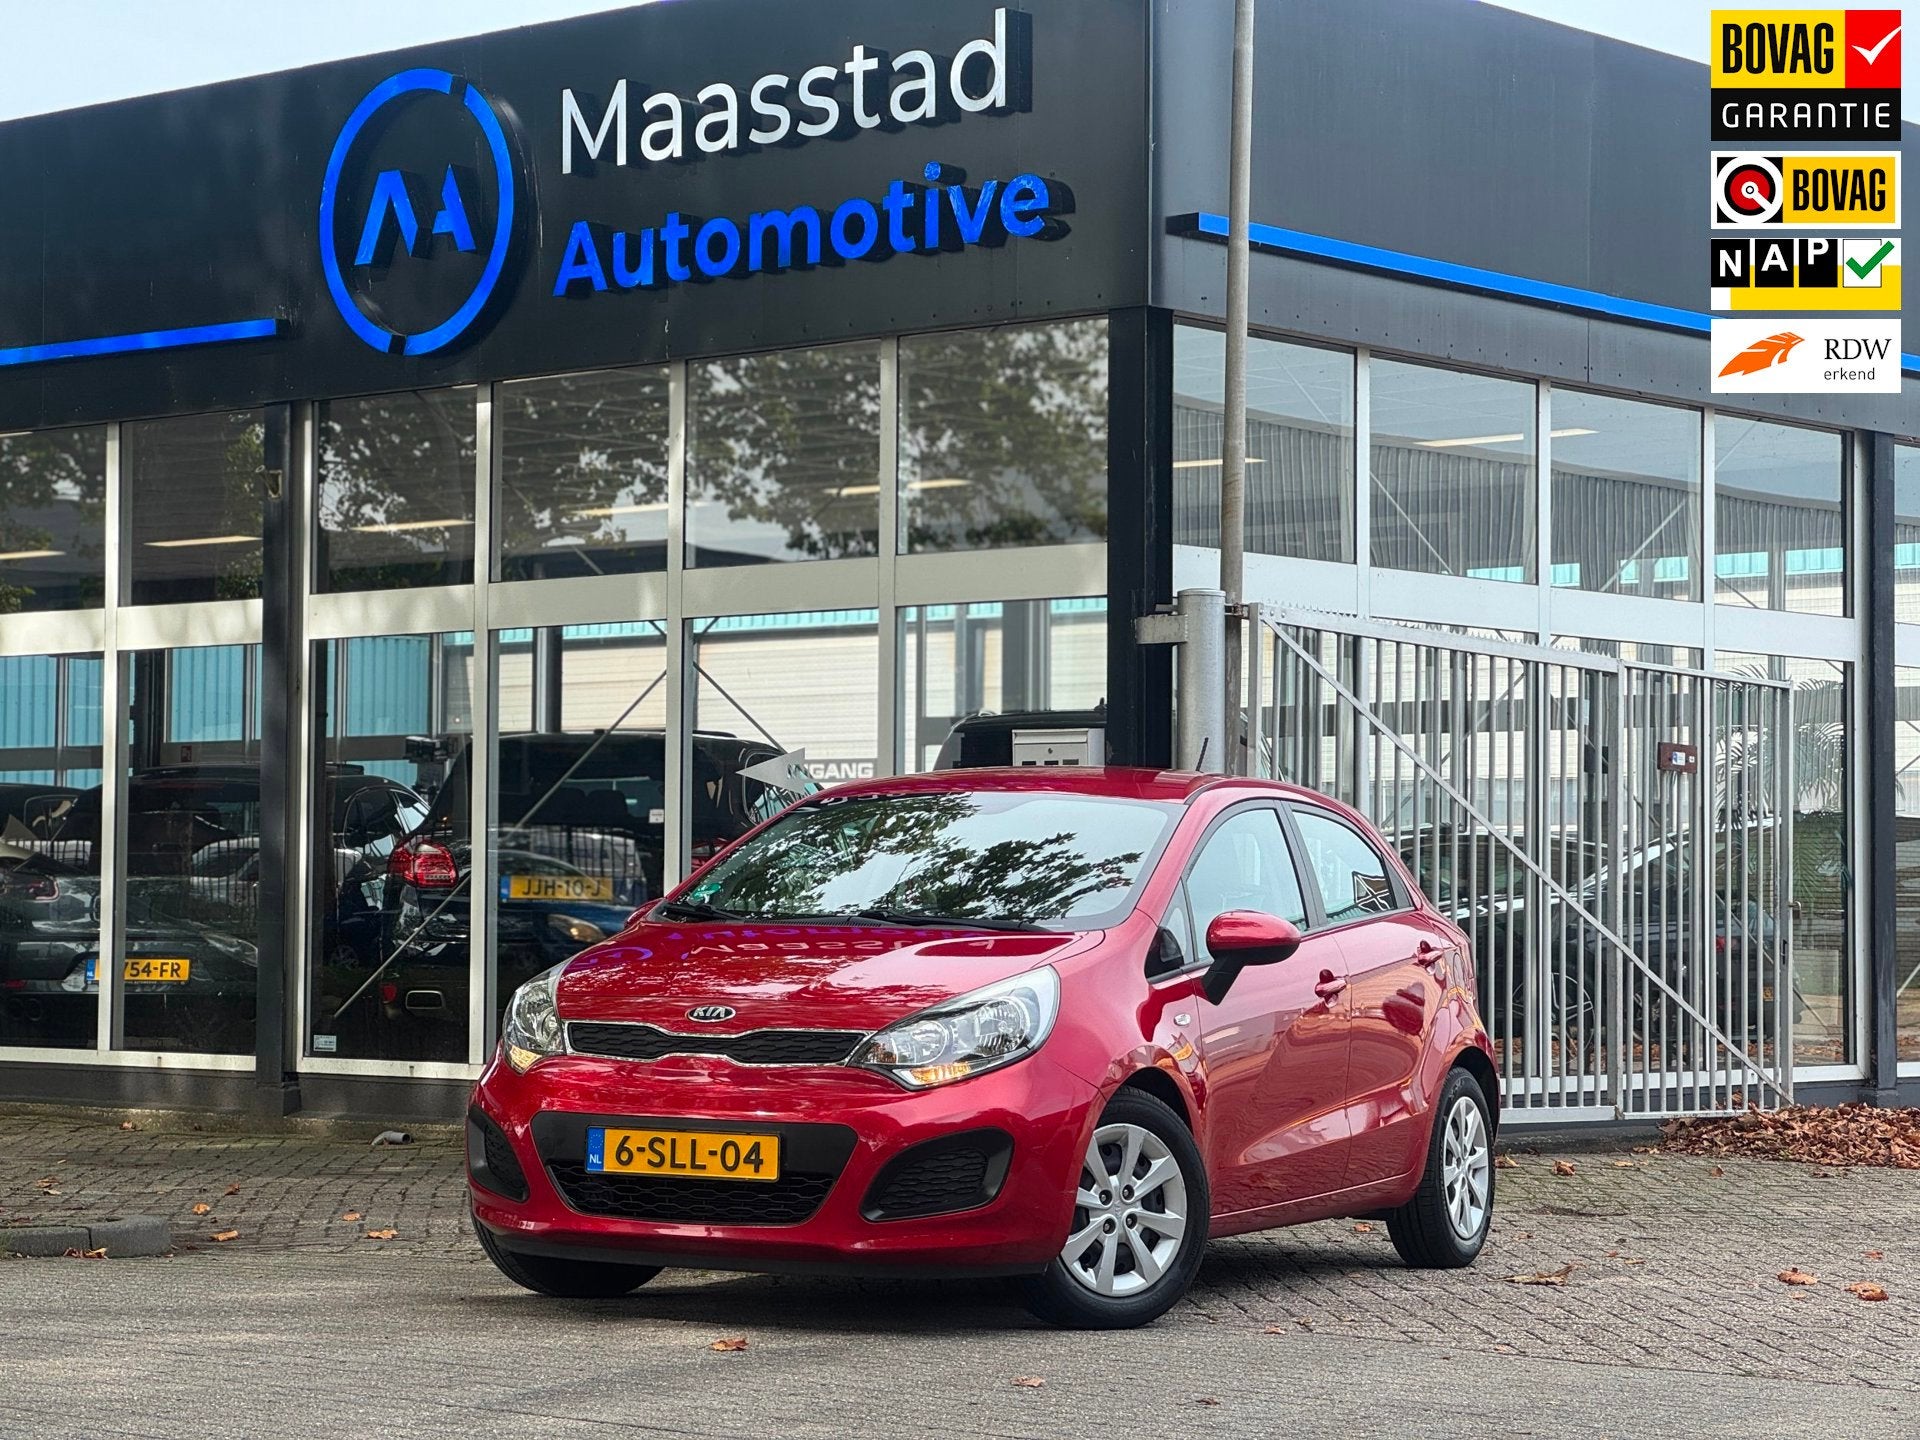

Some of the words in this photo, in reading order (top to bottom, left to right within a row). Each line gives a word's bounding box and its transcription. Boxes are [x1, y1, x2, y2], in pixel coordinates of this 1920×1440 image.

[561, 8, 1007, 175] Maasstad
[553, 162, 1049, 297] Automotive
[522, 879, 600, 897] JJH-10-J
[693, 1007, 726, 1018] KIA
[589, 1154, 602, 1164] NL
[615, 1135, 764, 1173] 6-SLL-04
